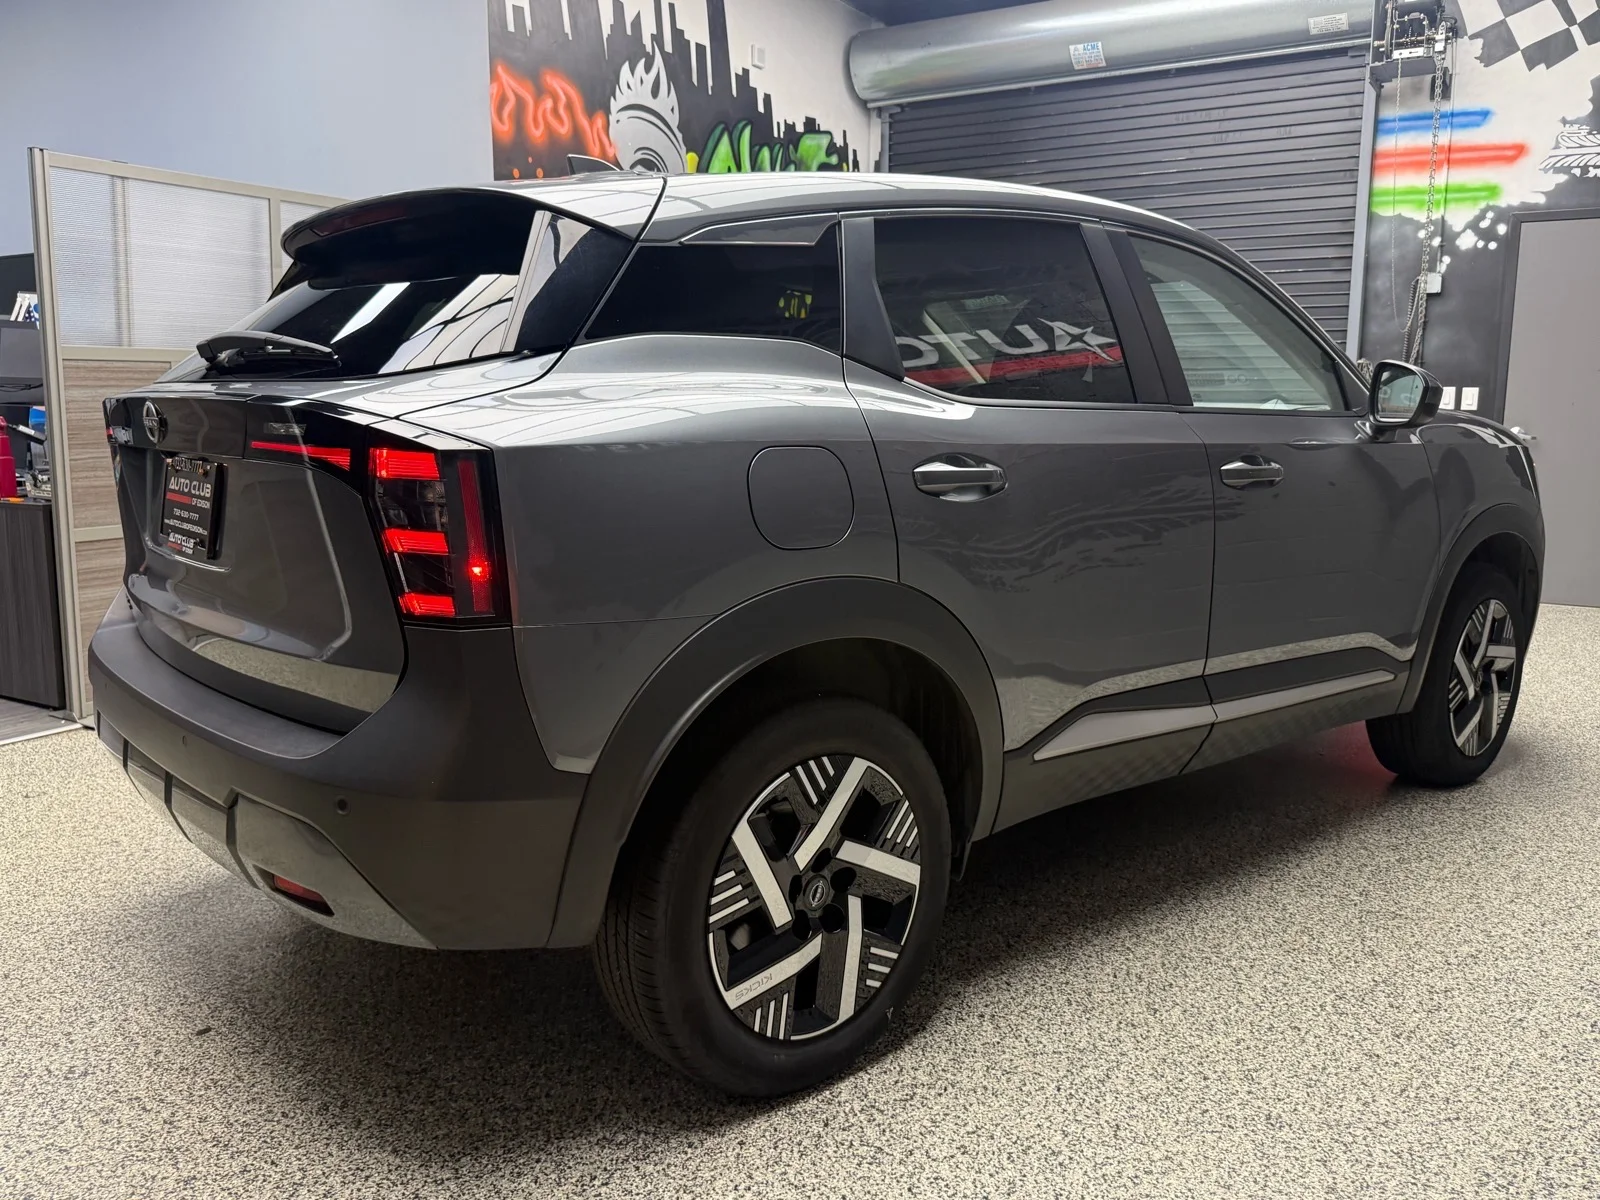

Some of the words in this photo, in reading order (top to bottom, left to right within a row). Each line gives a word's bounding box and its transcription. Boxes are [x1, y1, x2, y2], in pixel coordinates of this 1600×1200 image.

[1082, 42, 1100, 52] ACME
[169, 477, 190, 492] AUTO
[191, 481, 211, 497] CLUB
[197, 498, 210, 509] EDISON
[735, 973, 772, 1001] KICKS
